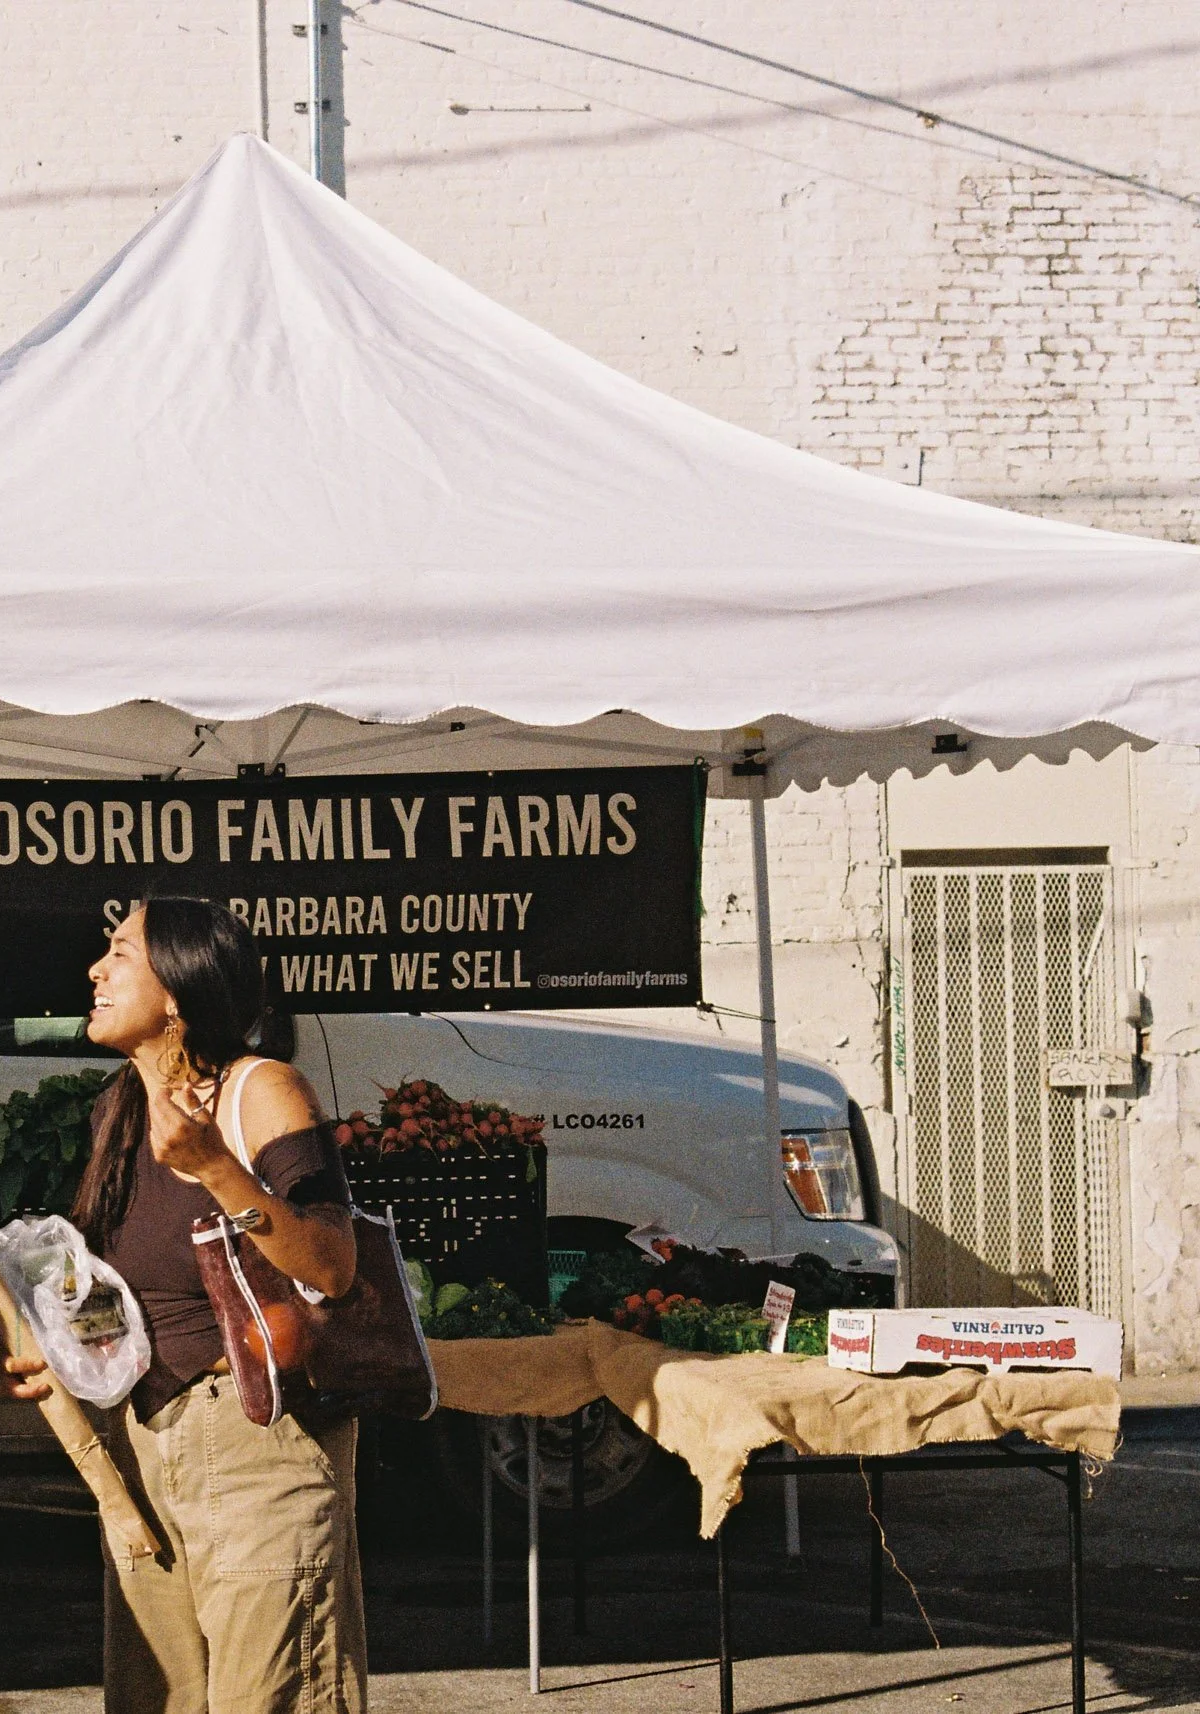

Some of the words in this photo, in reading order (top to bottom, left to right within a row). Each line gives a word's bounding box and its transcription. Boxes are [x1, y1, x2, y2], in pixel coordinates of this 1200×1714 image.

[218, 798, 425, 862] FAMILY
[448, 792, 637, 858] FARMS
[229, 895, 387, 937] BARBARA
[401, 892, 533, 934] COUNTY
[280, 954, 378, 993] WHAT
[390, 952, 440, 991] WE
[451, 950, 531, 990] SELL
[917, 1333, 1076, 1365] Strawberries
